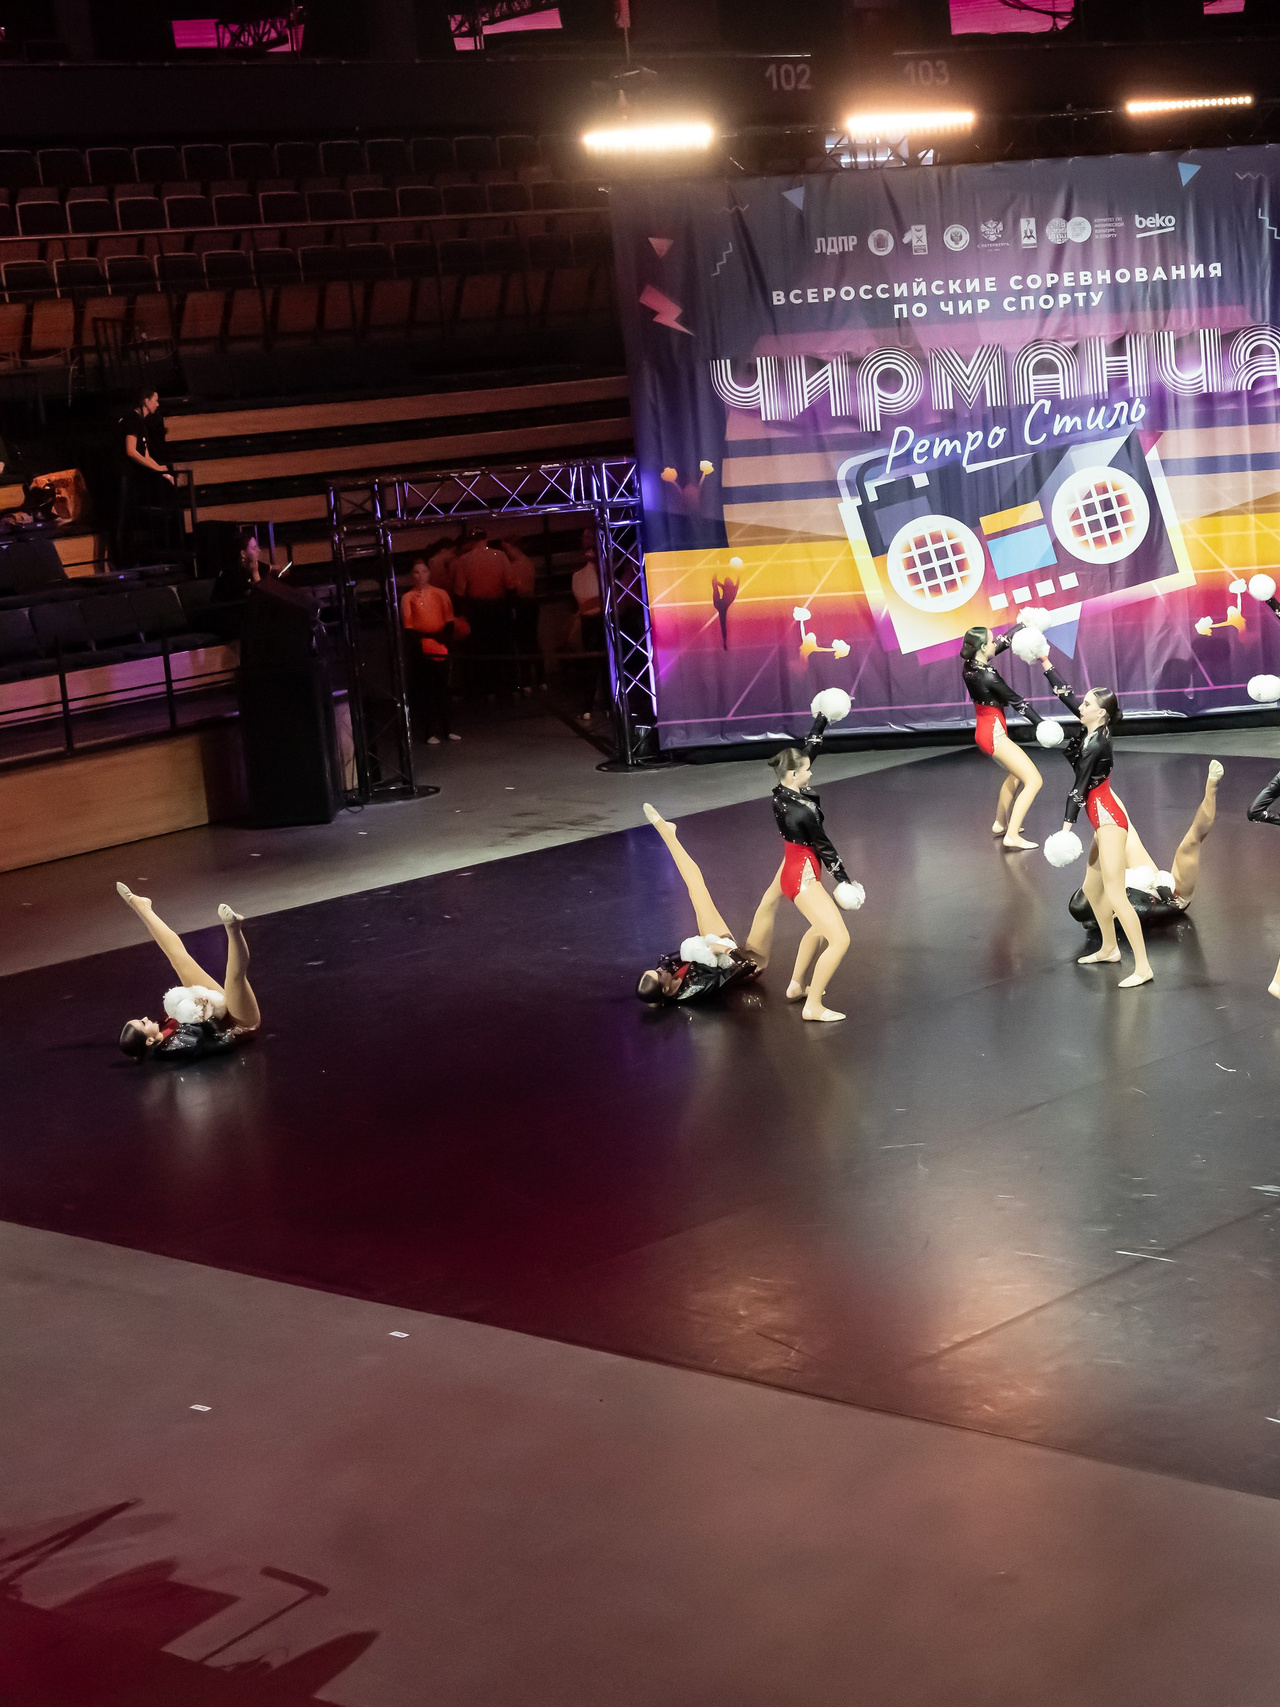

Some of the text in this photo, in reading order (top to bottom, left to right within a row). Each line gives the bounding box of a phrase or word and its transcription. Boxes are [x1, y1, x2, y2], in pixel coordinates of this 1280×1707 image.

[764, 63, 812, 91] 102
[904, 59, 949, 87] 103
[1134, 213, 1176, 229] beko
[814, 236, 858, 255] ЛДПР
[772, 262, 1223, 306] ВСЕРОССИЙСКИЕ СОРЕВНОВАНИЯ
[893, 291, 1104, 319] ПО ЧИР СПОРТУ
[885, 397, 1147, 474] Ретро Стиль
